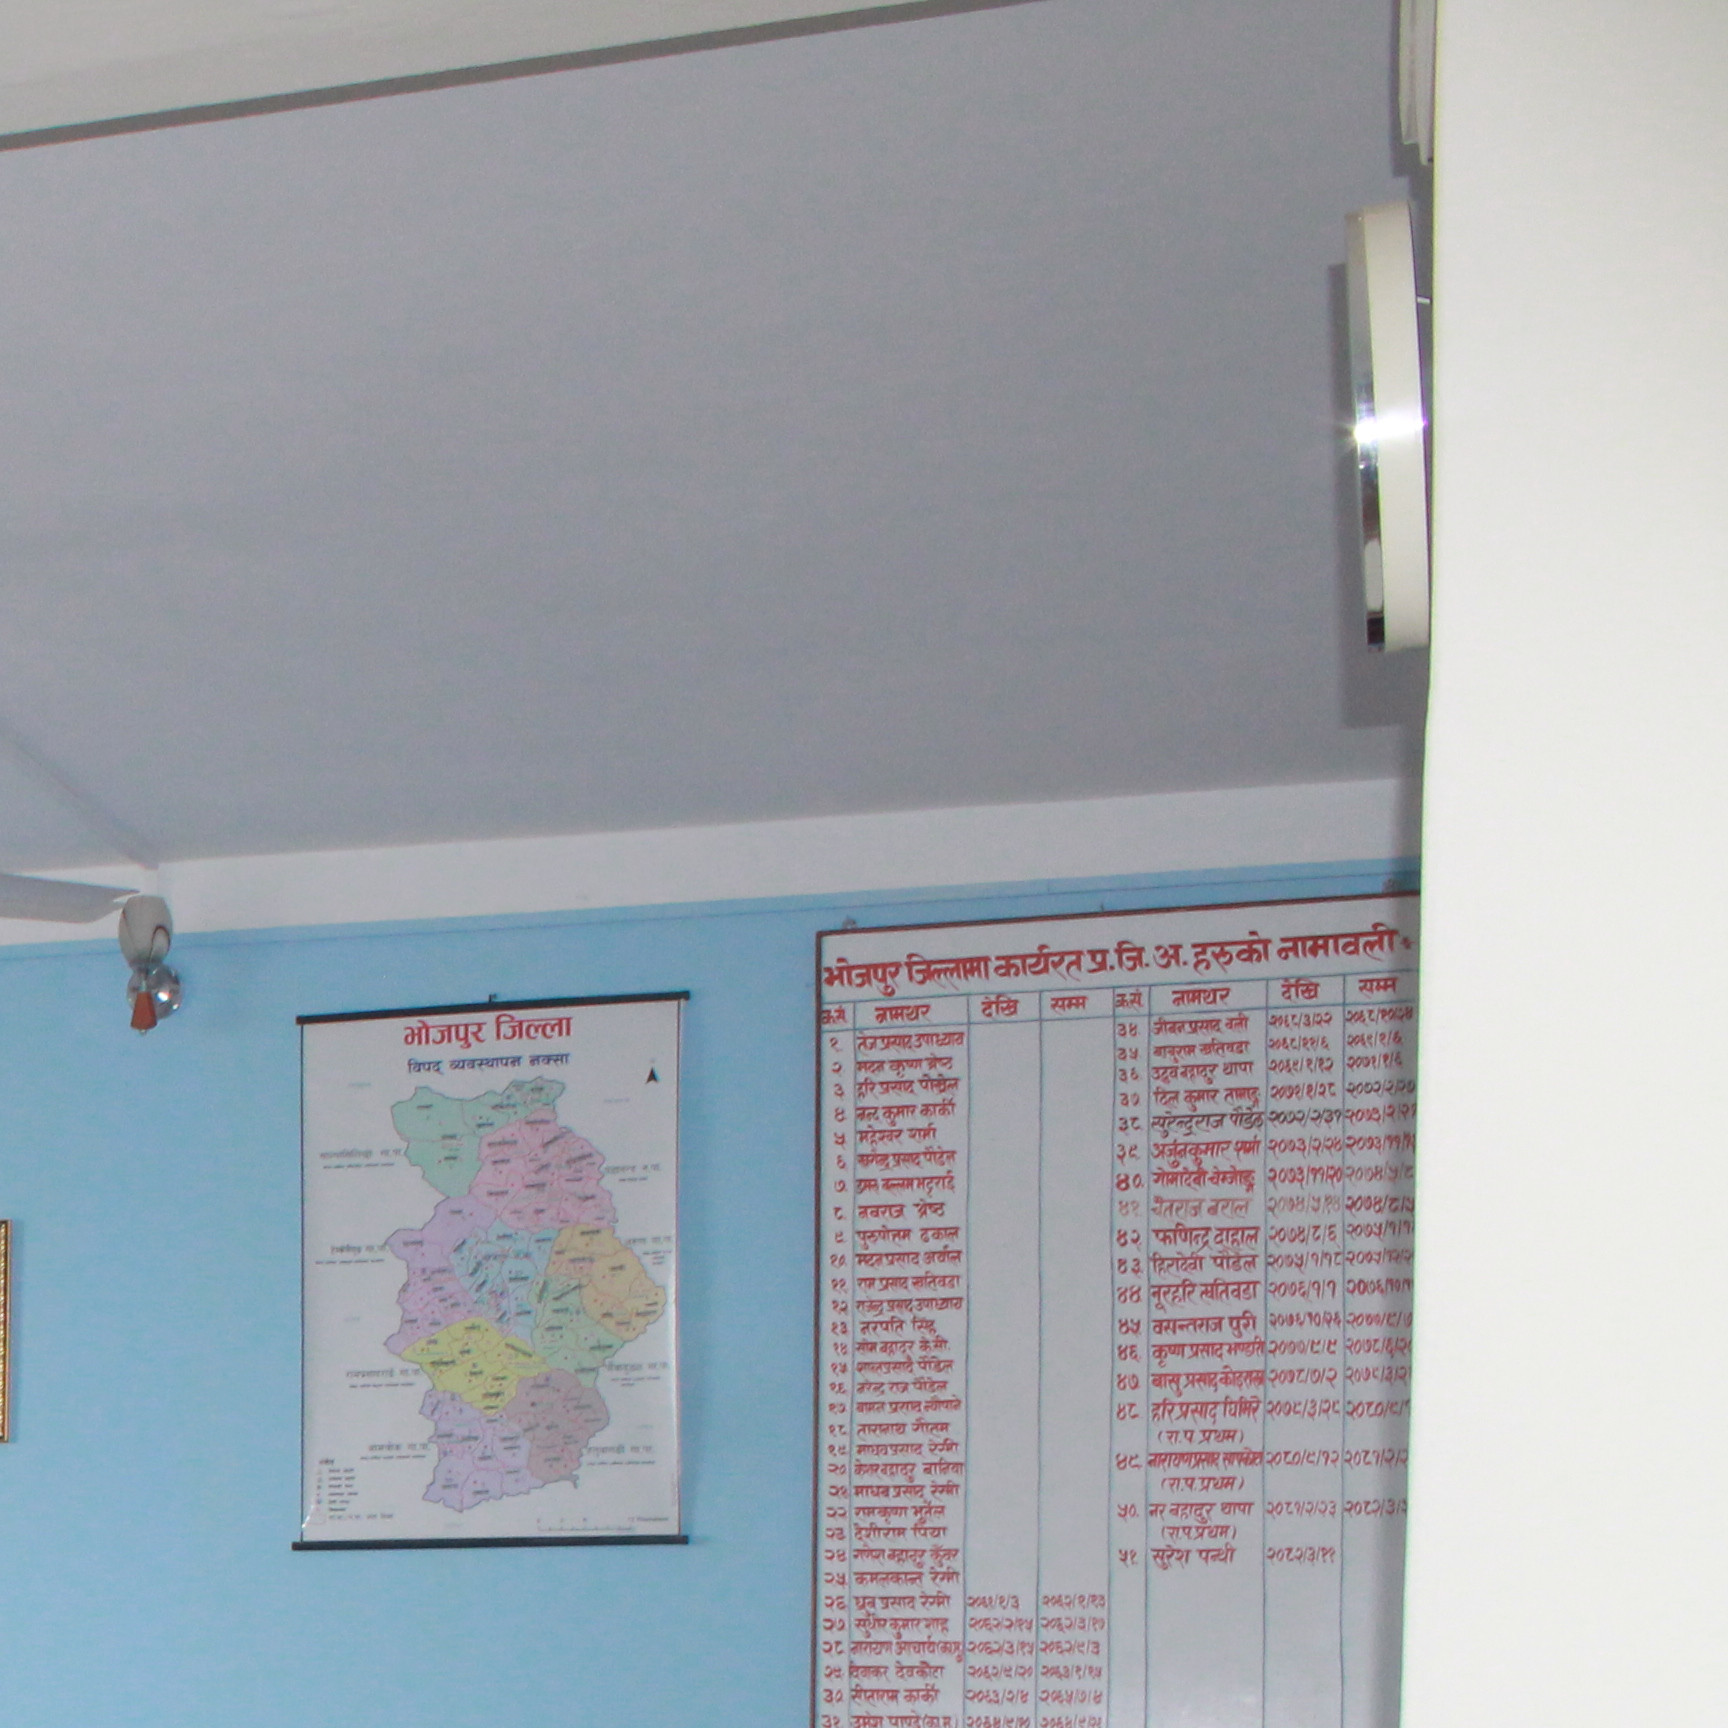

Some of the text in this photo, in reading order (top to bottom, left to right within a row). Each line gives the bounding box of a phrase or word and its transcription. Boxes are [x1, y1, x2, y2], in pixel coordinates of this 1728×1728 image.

[823, 957, 901, 997] भोजपुर
[905, 954, 990, 990] जिल्लामा
[993, 945, 1082, 981] कार्यरत
[1278, 922, 1398, 961] नामावली
[874, 978, 1398, 1023] नामथर देखि सम्म नामथर देखि सम्म
[404, 1013, 573, 1049] भोजपुर जिल्ला
[449, 1055, 522, 1072] व्यवस्थापन
[529, 1052, 570, 1067] नक्सा
[1223, 1062, 1254, 1075] थापा
[1221, 1502, 1254, 1516] थापा
[1152, 1545, 1191, 1570] सुरेश
[1196, 1542, 1236, 1565] पन्थी
